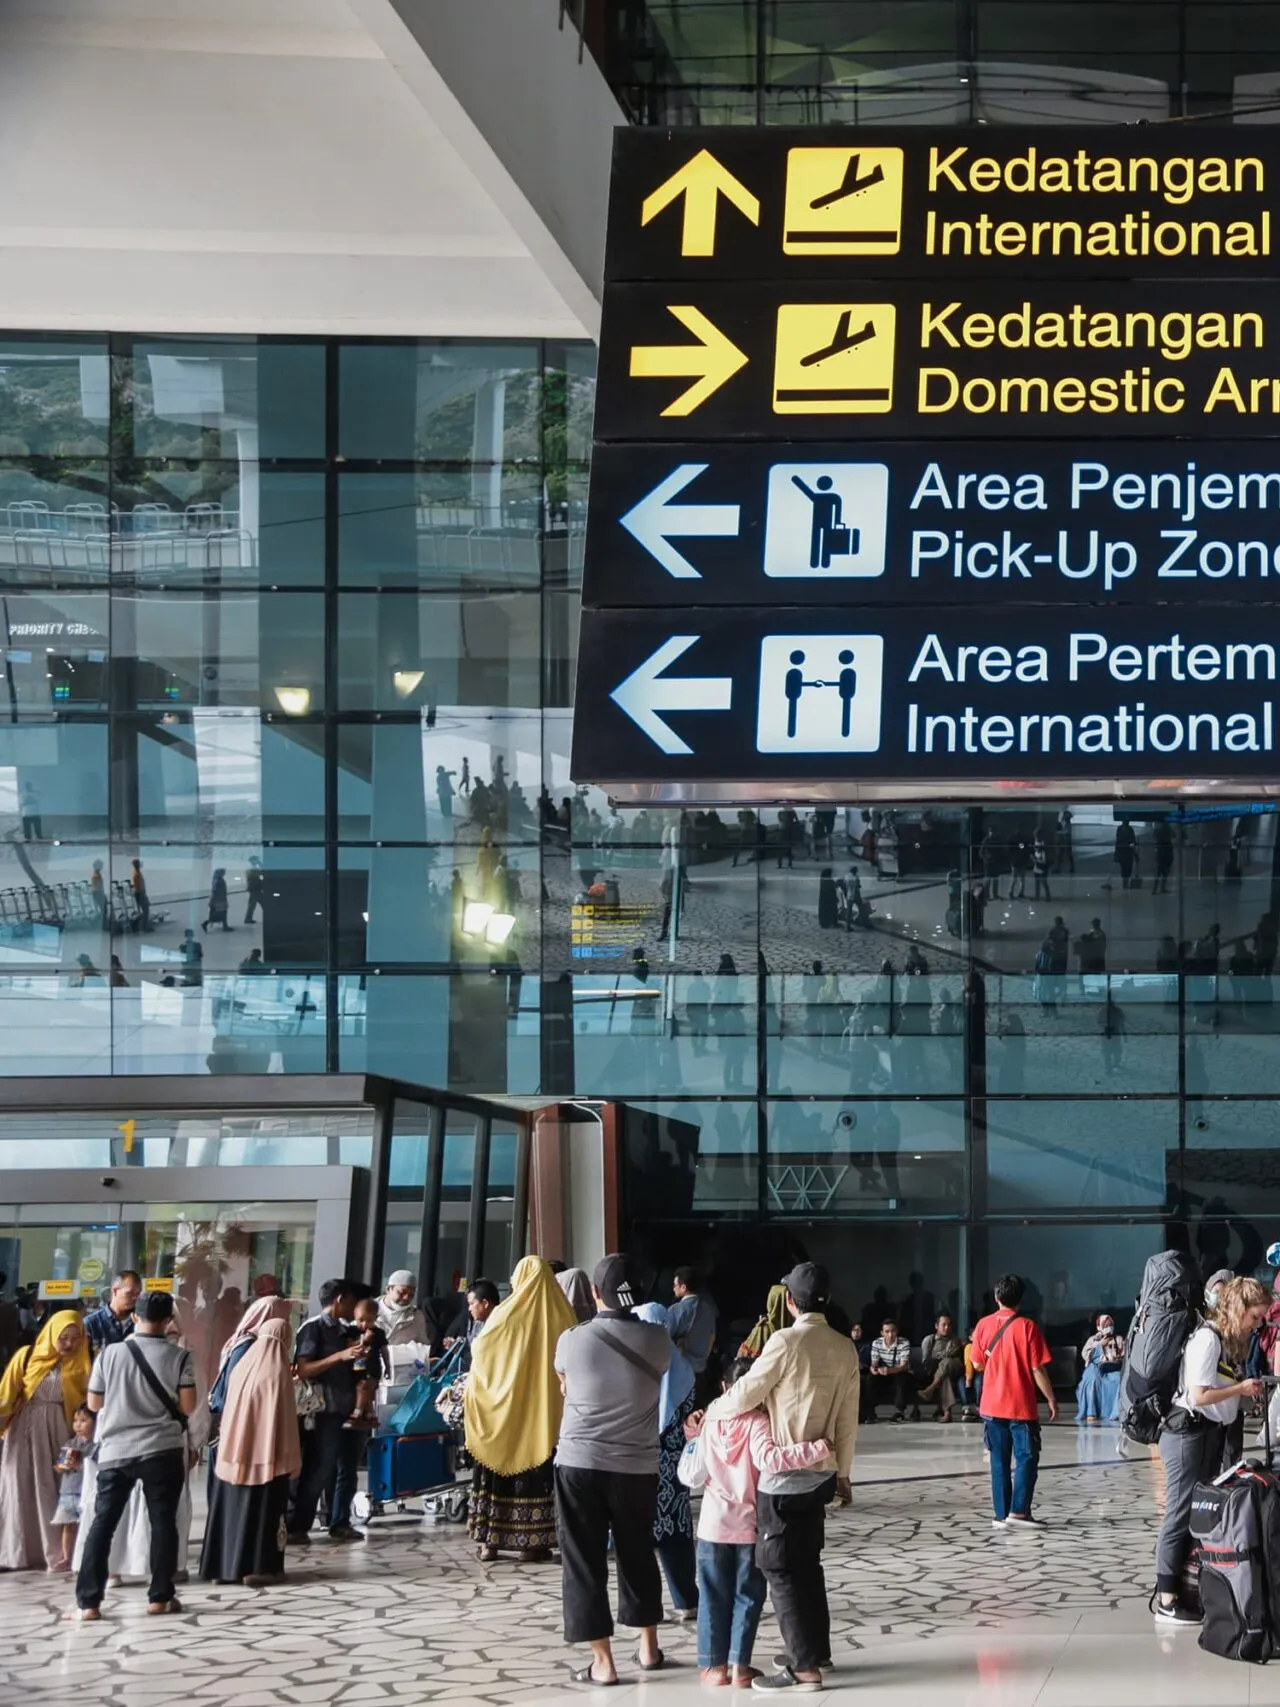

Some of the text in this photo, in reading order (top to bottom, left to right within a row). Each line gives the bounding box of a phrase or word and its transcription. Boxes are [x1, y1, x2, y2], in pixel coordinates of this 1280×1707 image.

[929, 148, 1263, 204] Kedatangan
[926, 211, 1269, 255] International
[921, 303, 1262, 360] Kedatangan
[918, 367, 1184, 413] Domestic
[910, 463, 1047, 510] Area
[911, 531, 1137, 590] Pick-Up
[908, 635, 1048, 682] Area
[908, 702, 1272, 752] International
[117, 1119, 134, 1152] 1
